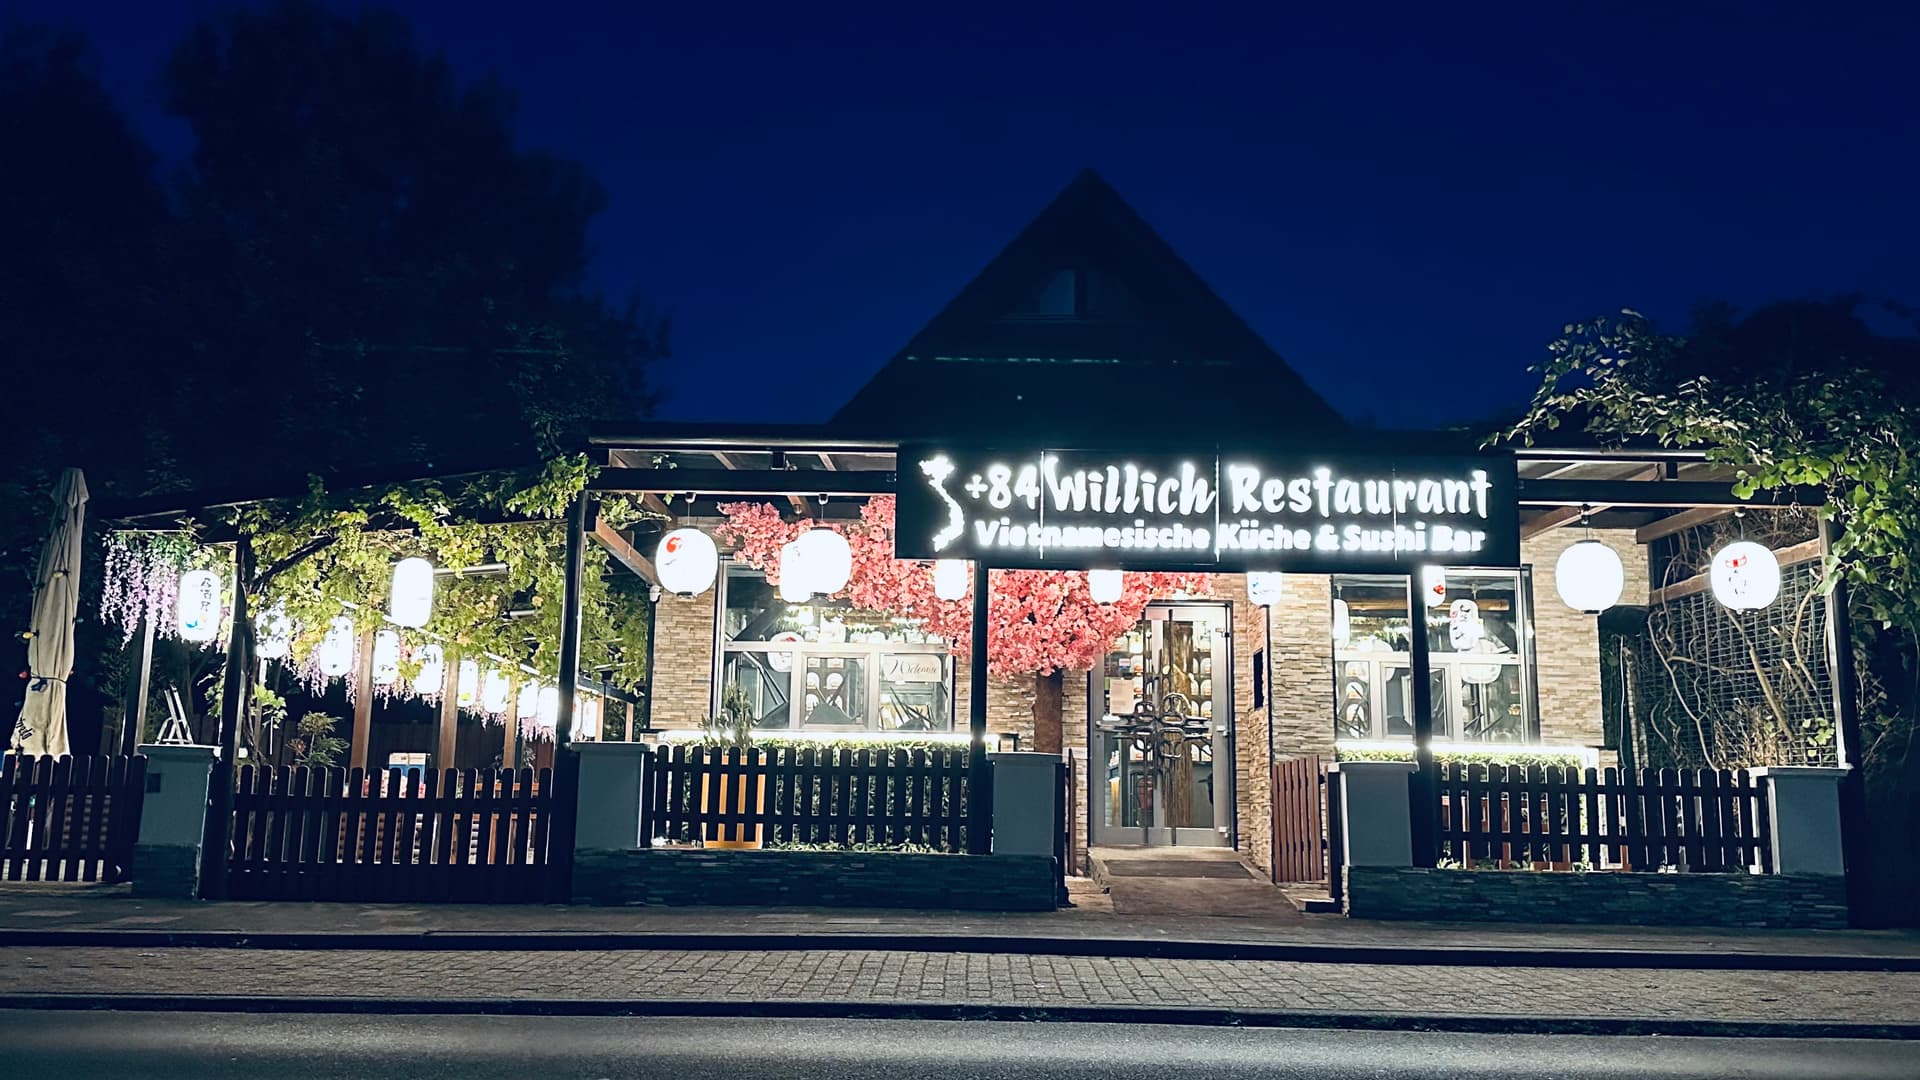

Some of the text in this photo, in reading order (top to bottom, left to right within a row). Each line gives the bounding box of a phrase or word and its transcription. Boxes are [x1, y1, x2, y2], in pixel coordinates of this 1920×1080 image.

[964, 455, 1492, 519] +84 Willich Restaurant
[974, 517, 1486, 551] Vietnamesische Küche & Sushi Bar
